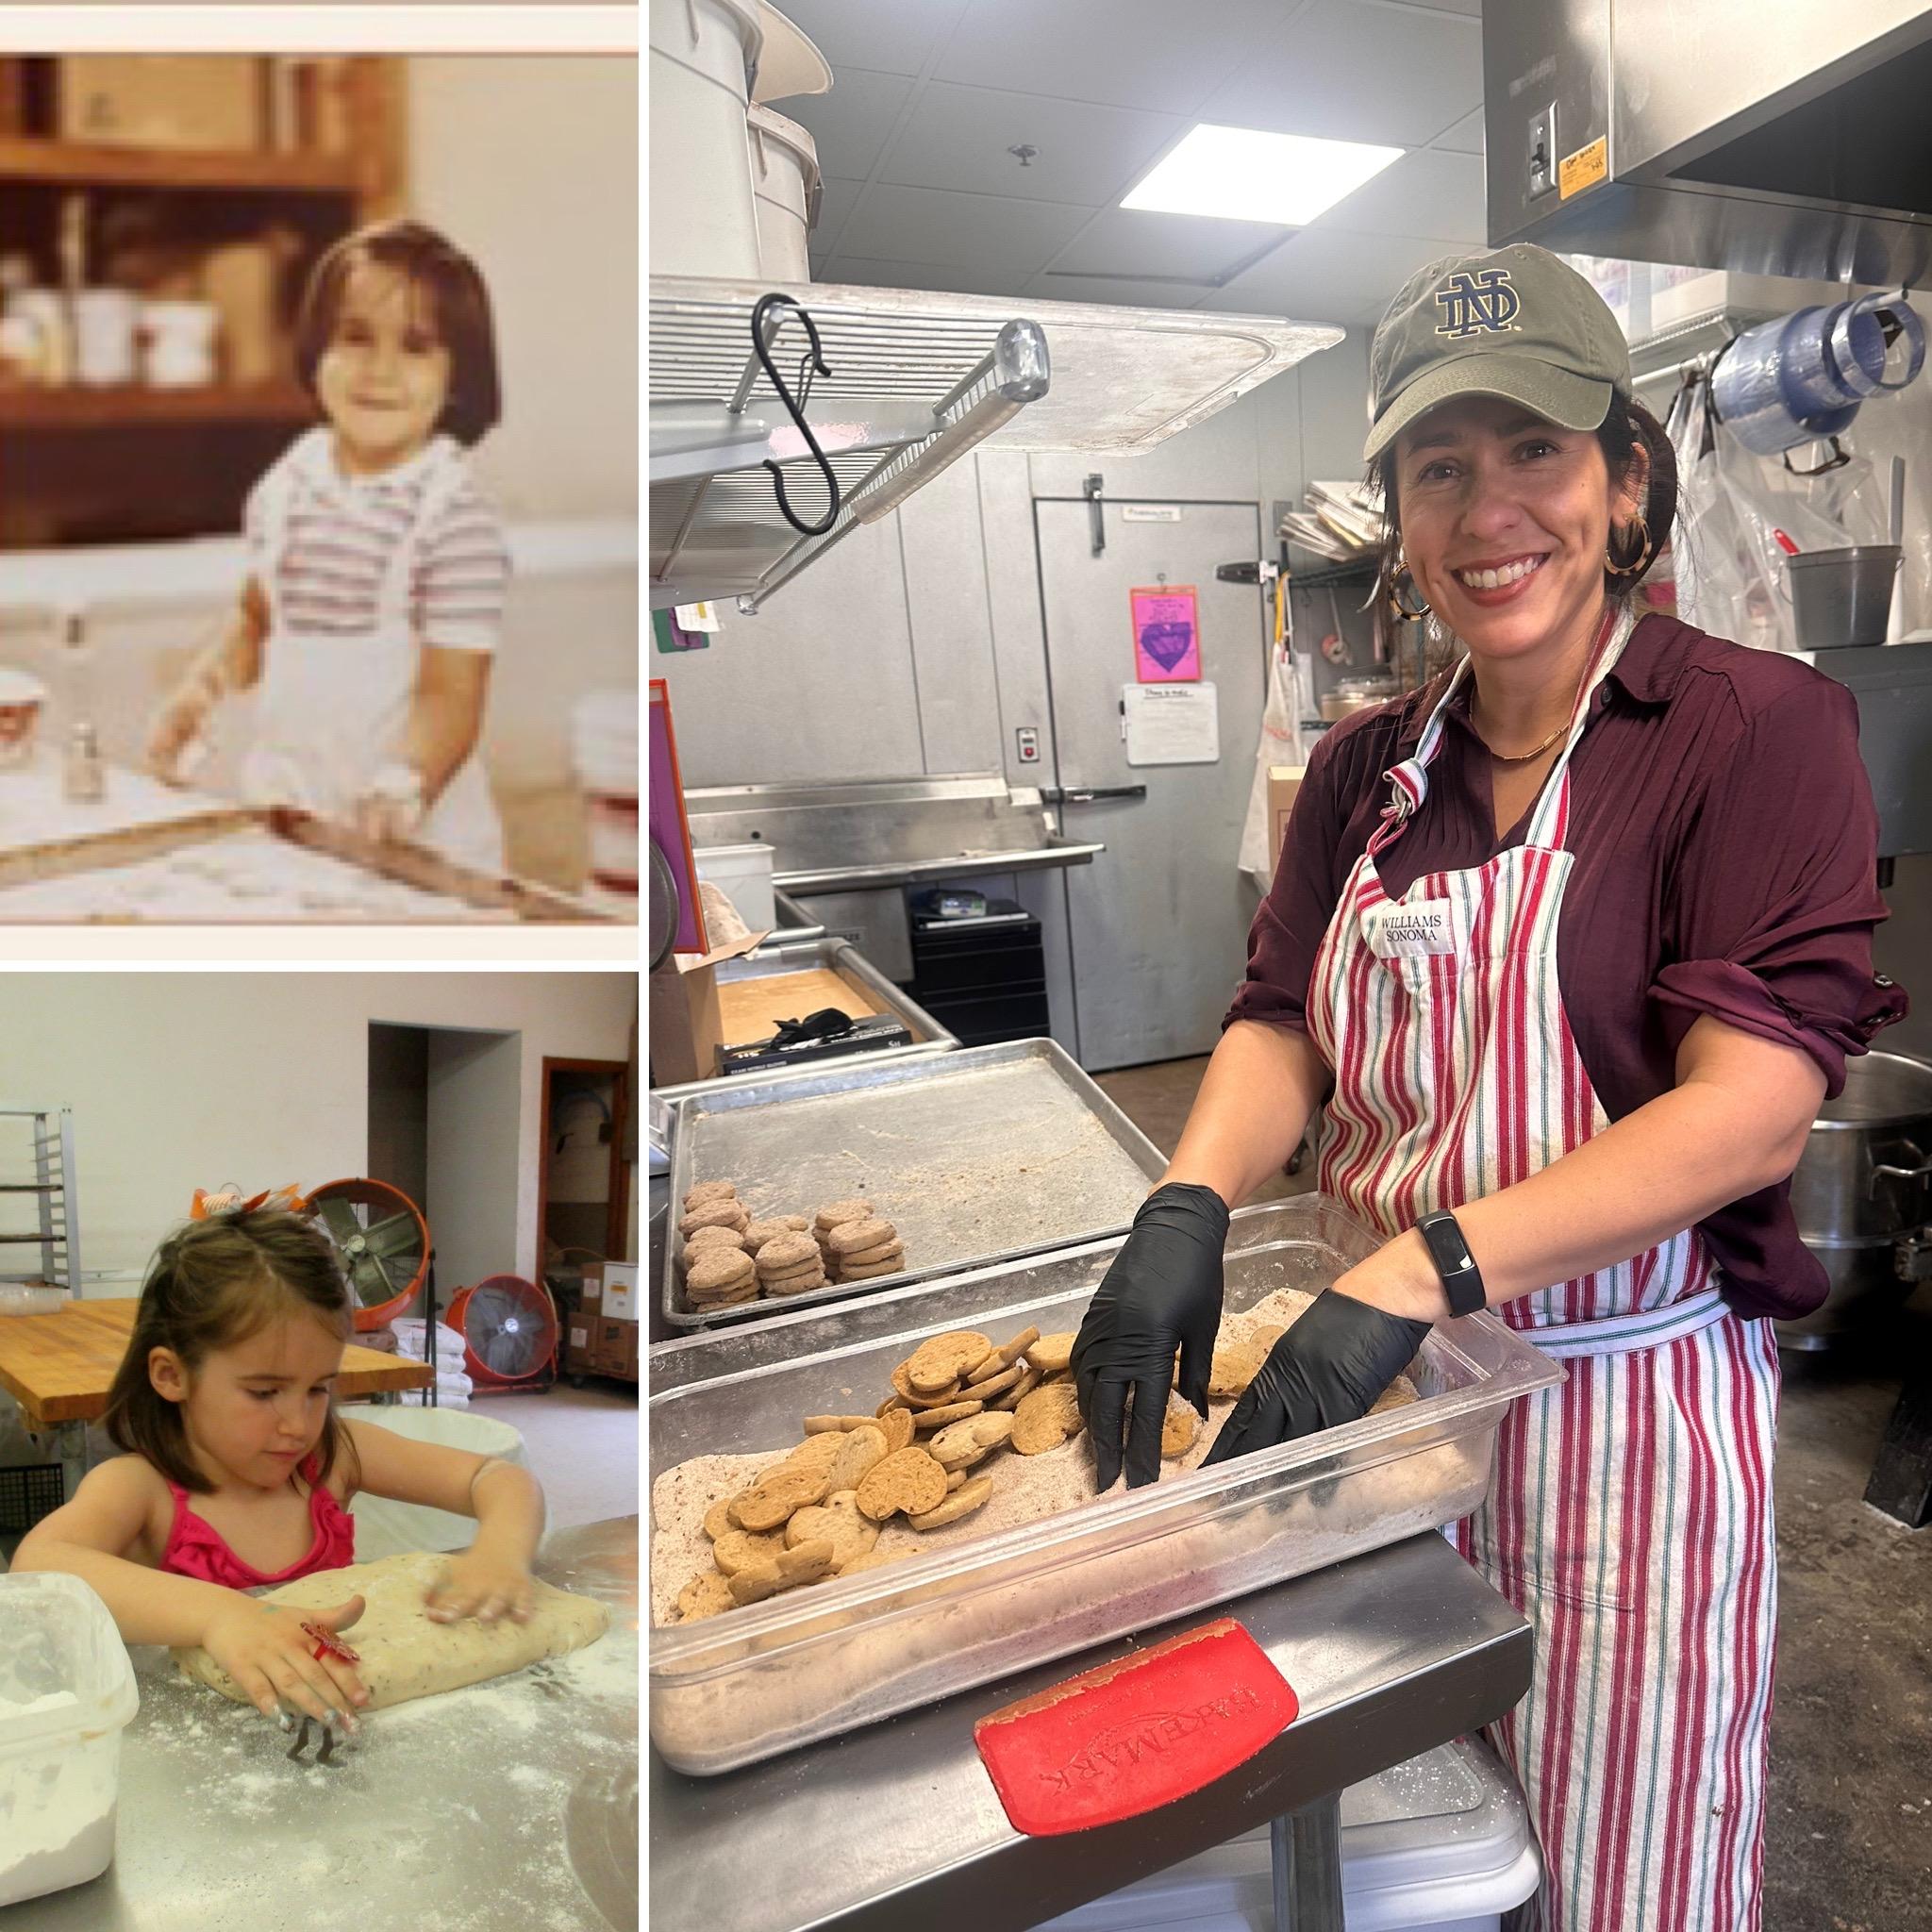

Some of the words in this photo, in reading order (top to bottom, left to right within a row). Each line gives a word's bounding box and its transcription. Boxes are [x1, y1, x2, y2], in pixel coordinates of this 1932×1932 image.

[1434, 269, 1521, 339] ND
[1382, 914, 1441, 929] WILLIAMS
[1386, 928, 1437, 941] SONOMA
